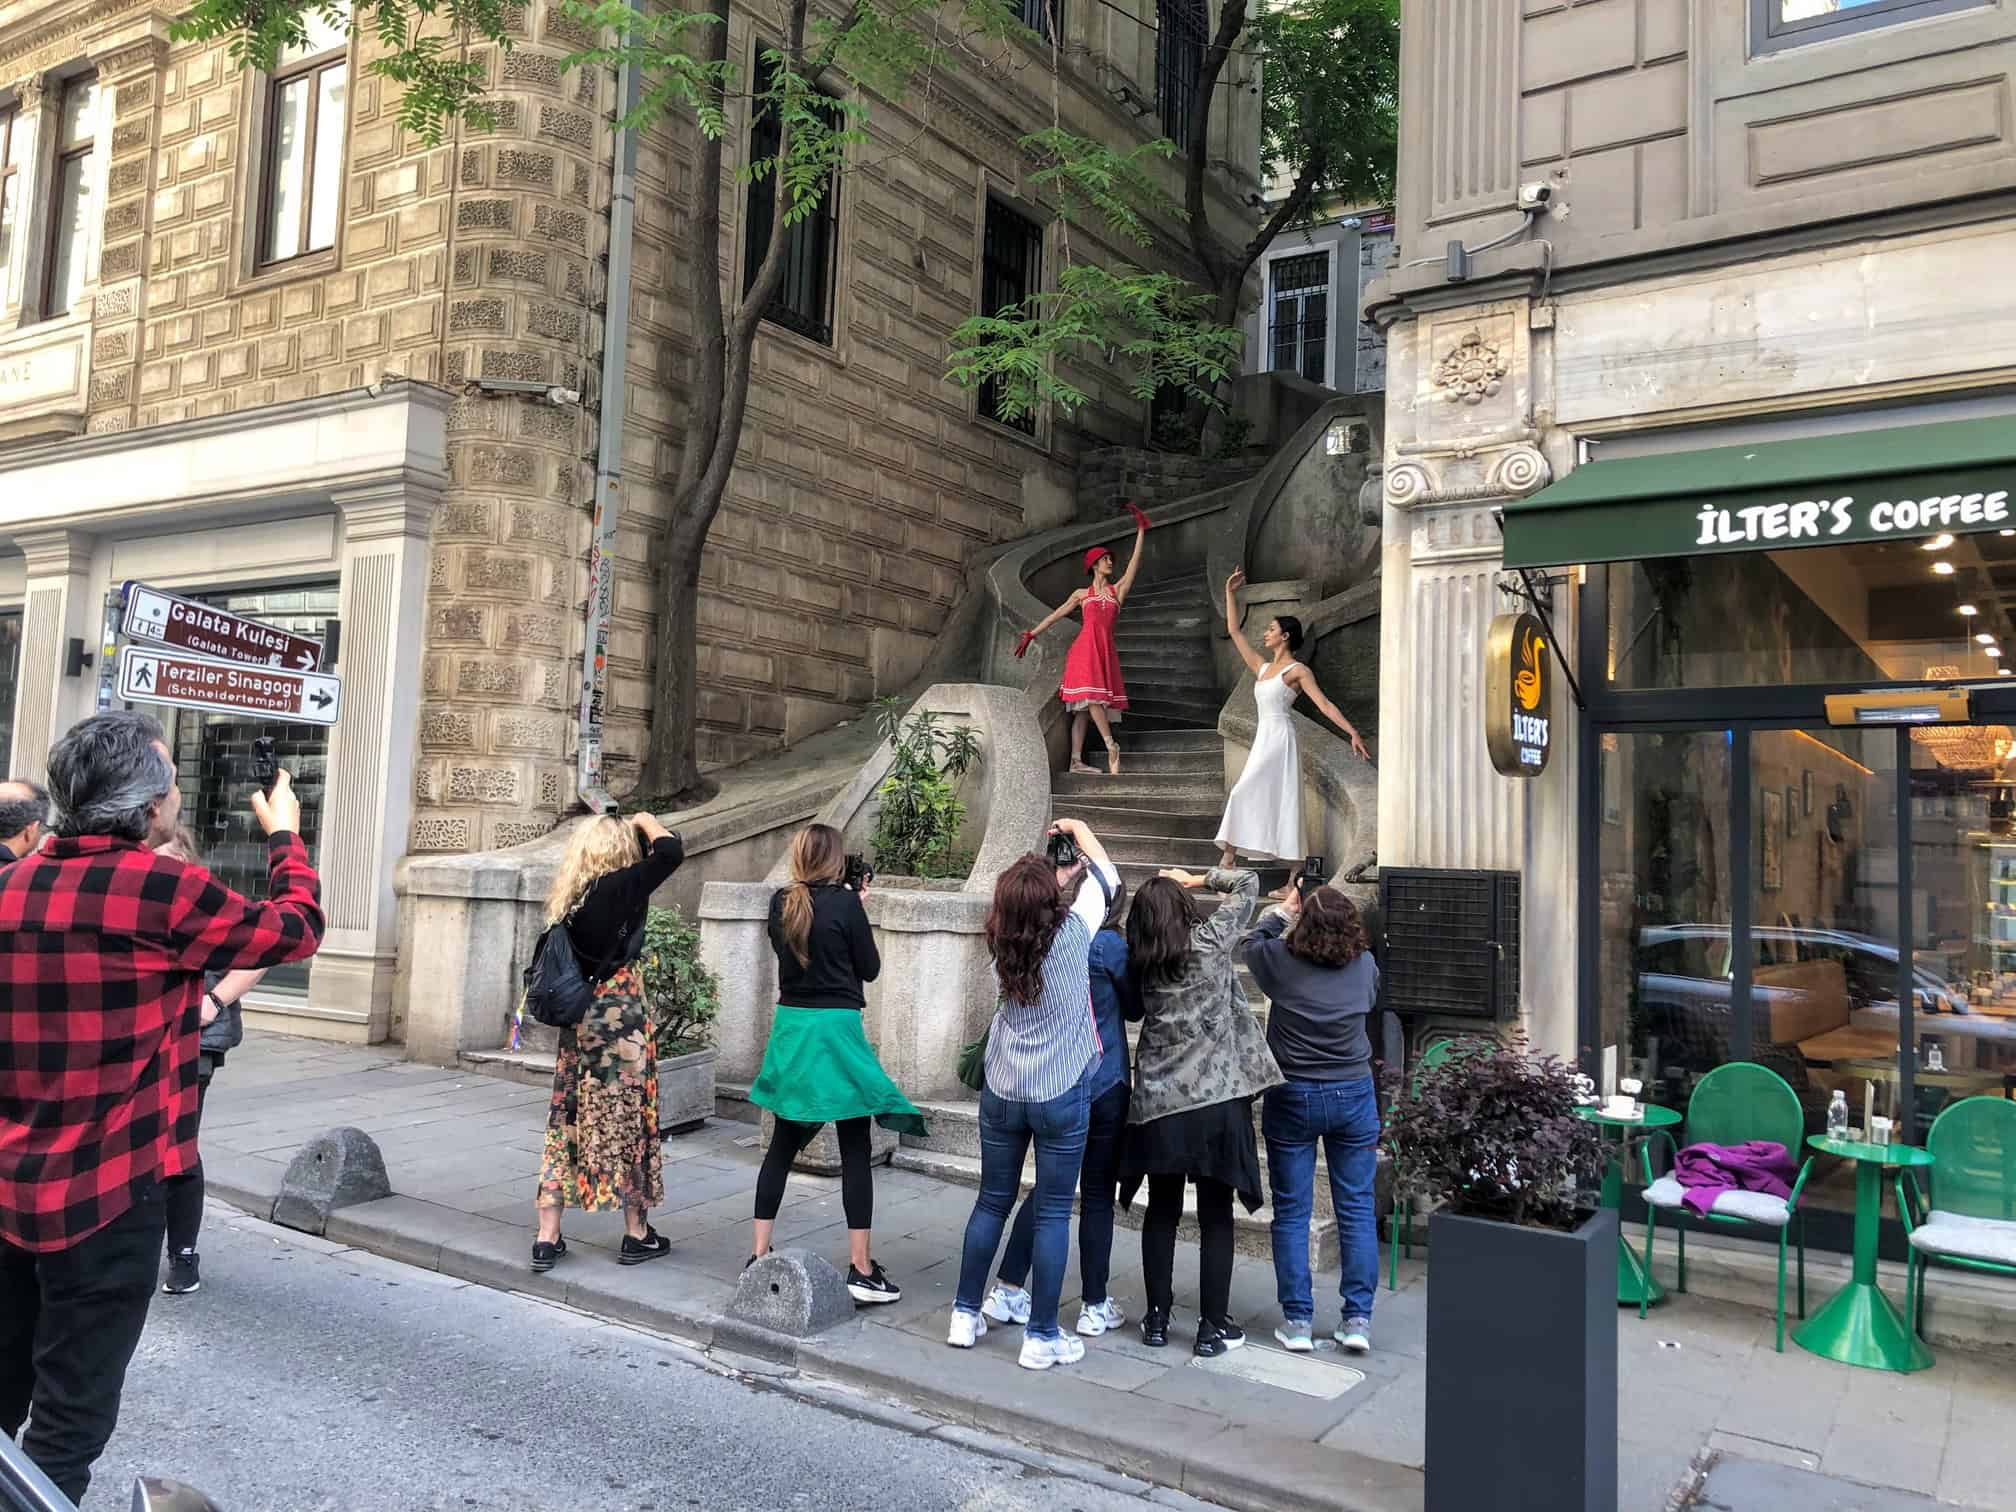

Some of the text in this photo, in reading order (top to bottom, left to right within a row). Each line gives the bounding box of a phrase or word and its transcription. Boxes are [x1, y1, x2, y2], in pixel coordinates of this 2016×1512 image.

[1696, 491, 2009, 545] İLTER'S COFFEE
[172, 604, 290, 653] Galata Kulesi
[187, 634, 228, 656] (Galata
[160, 661, 303, 698] Terziler Sinagogu
[167, 683, 292, 711] (Schneidertempel)
